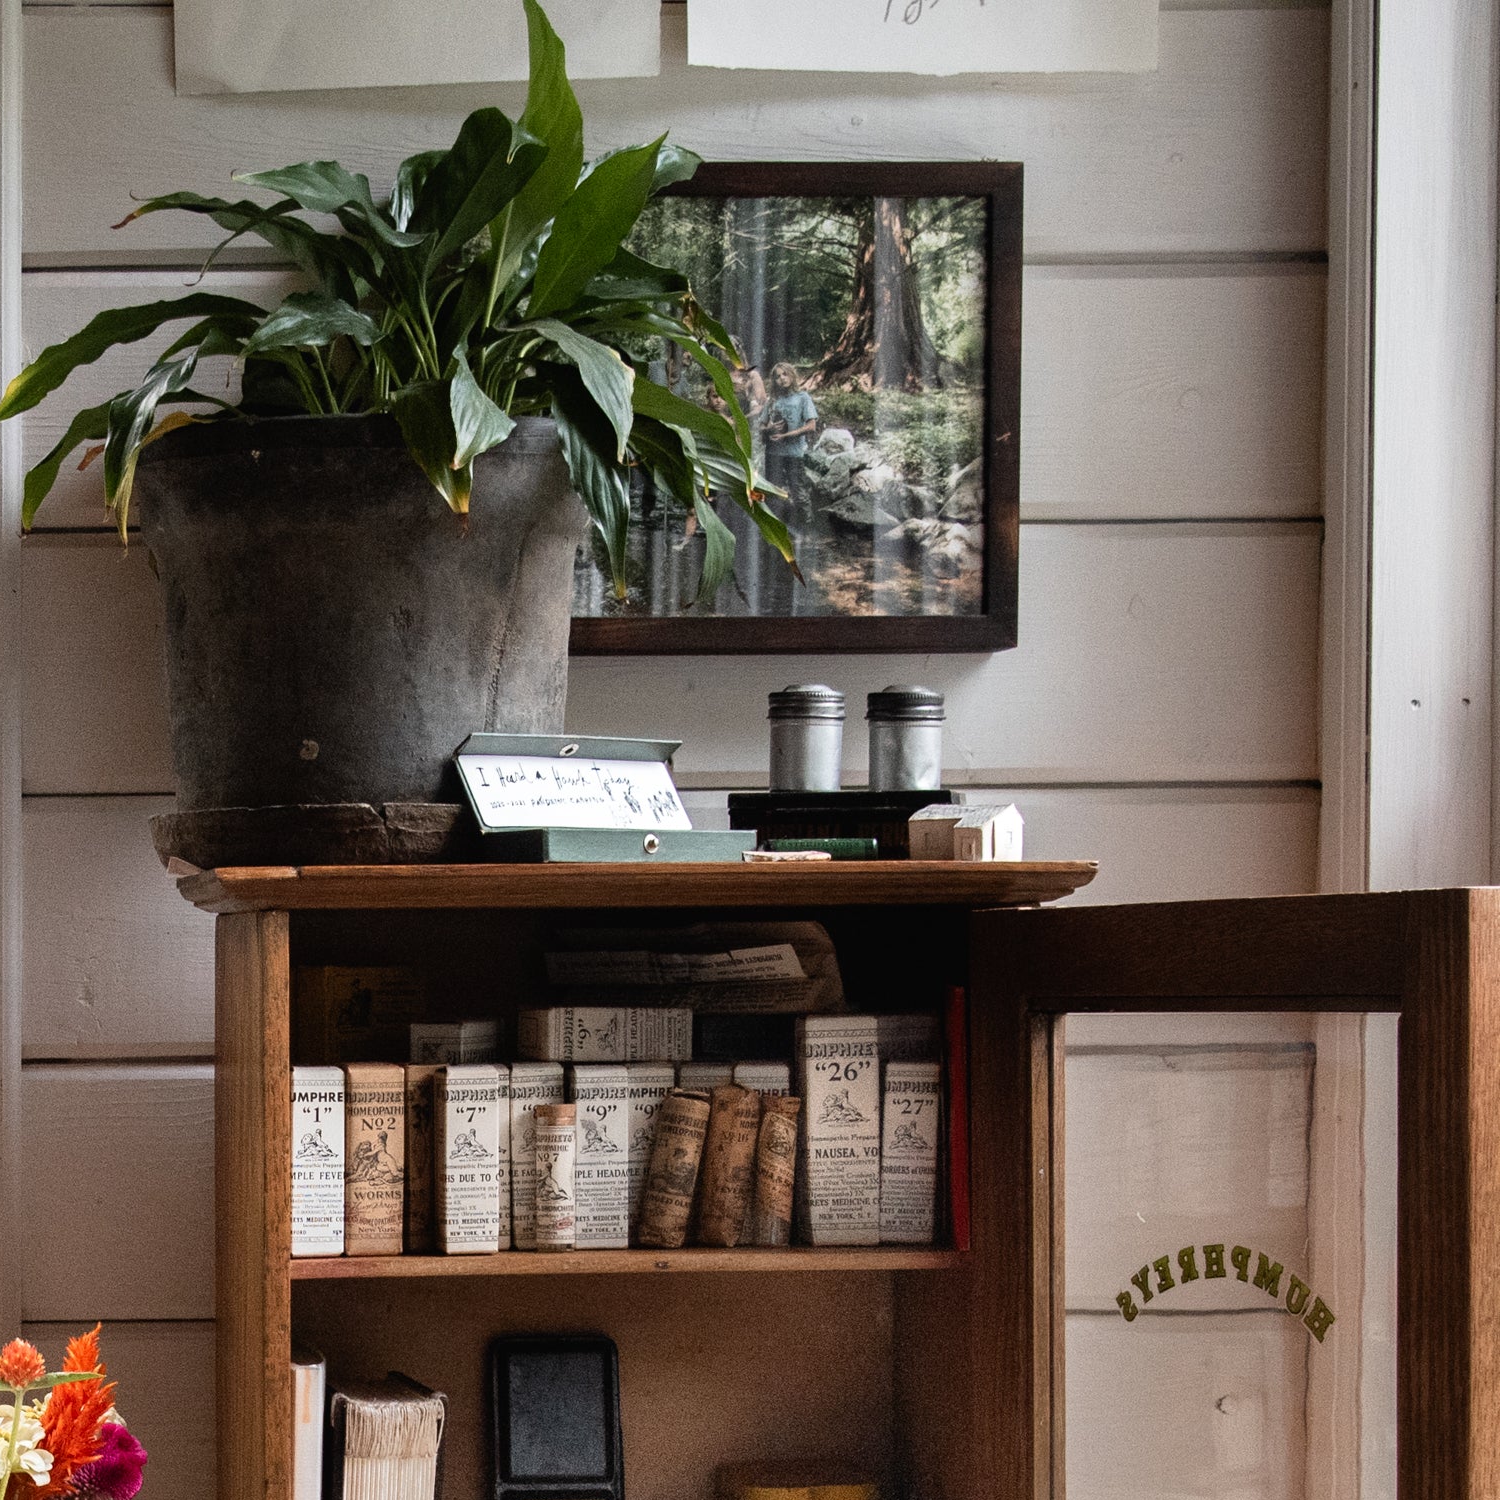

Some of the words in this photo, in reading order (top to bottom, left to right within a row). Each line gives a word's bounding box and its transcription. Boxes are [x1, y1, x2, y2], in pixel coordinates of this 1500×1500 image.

[497, 762, 532, 788] Heard
[459, 1173, 476, 1183] DUE
[480, 1173, 491, 1182] TO
[353, 1191, 402, 1199] WORMS
